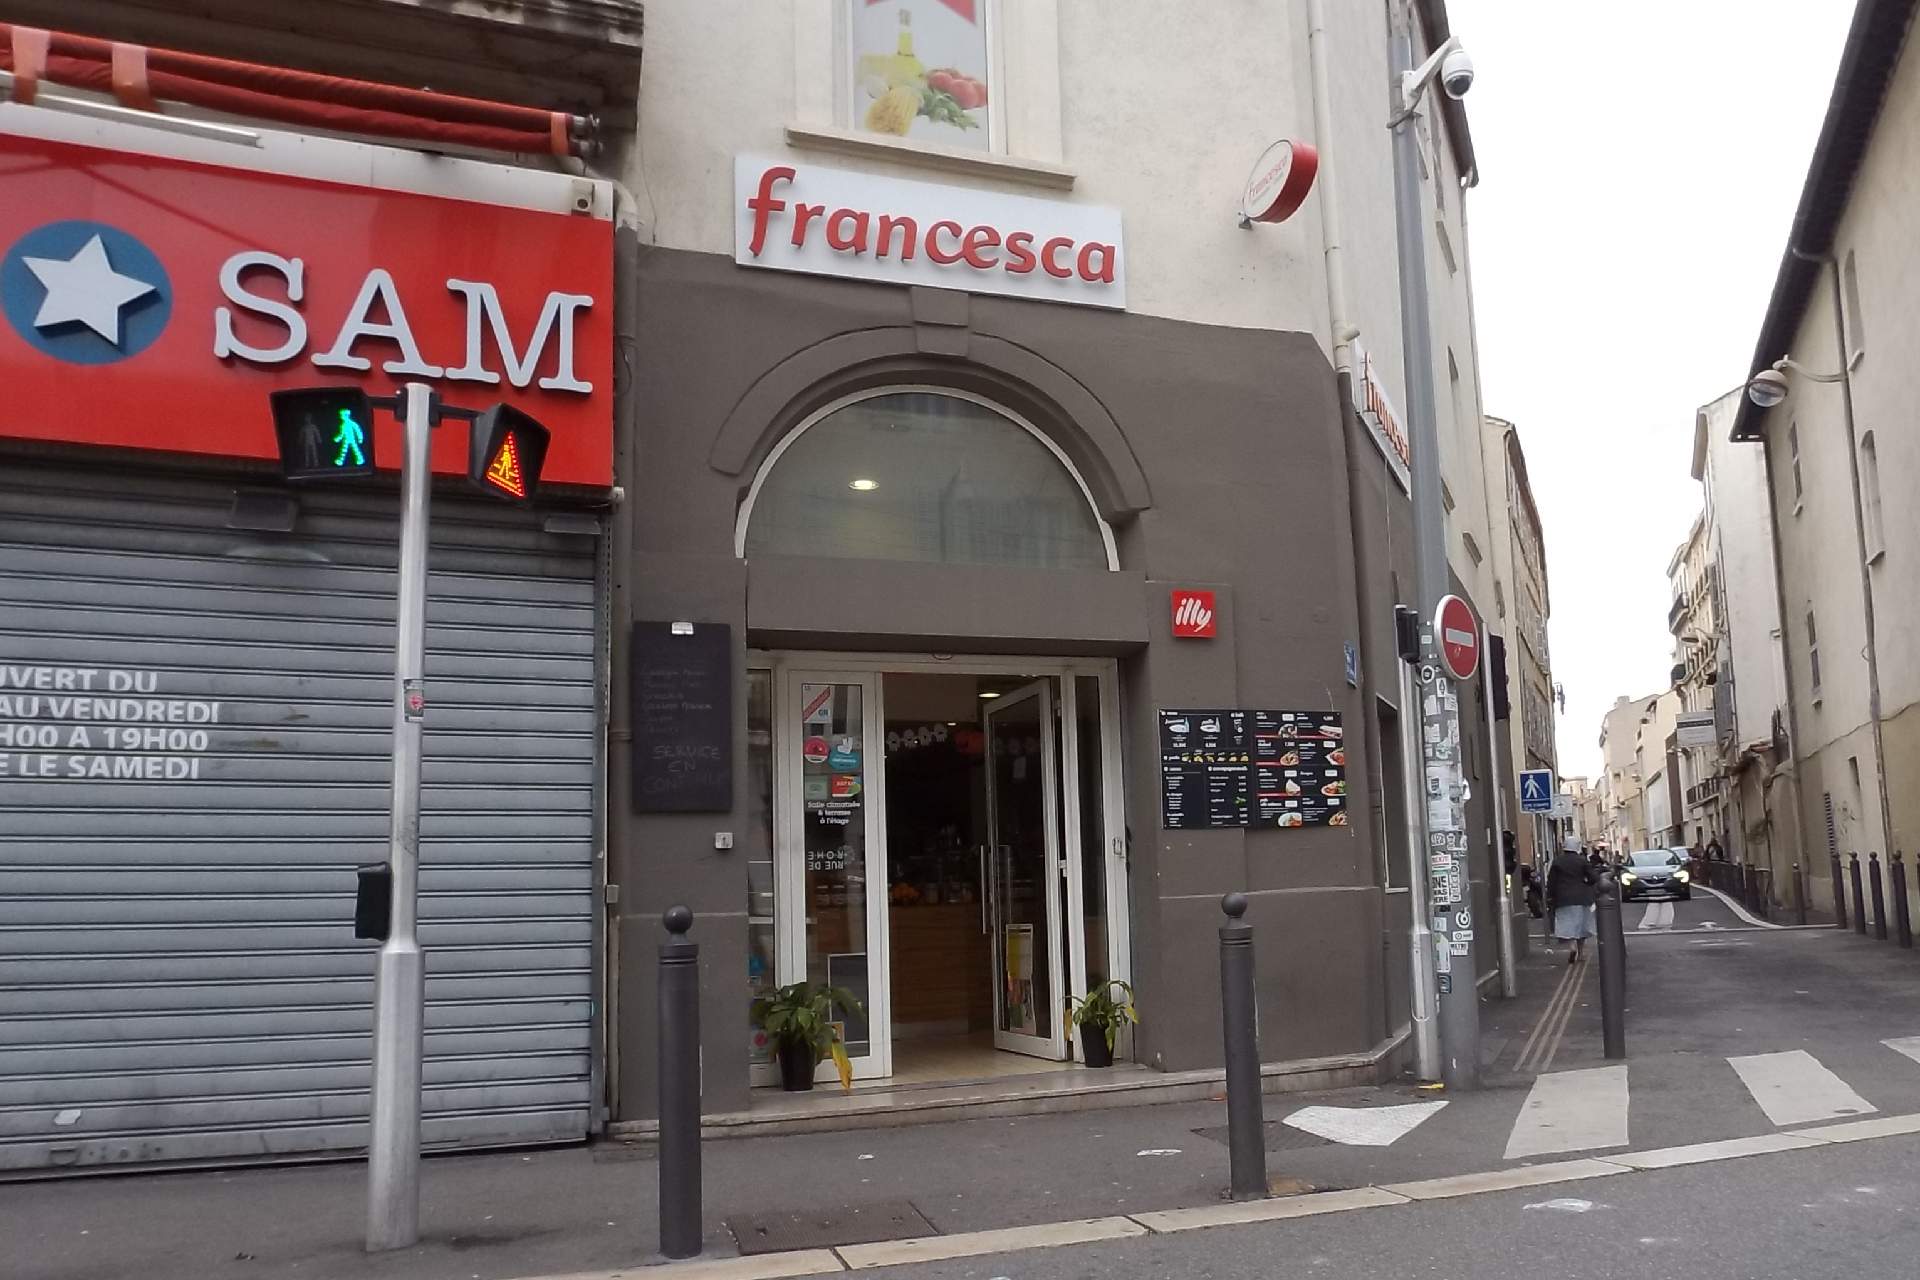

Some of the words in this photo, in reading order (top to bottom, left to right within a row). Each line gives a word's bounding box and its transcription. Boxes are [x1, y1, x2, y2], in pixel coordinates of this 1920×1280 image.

[747, 166, 1116, 285] francesca
[213, 251, 594, 394] SAM
[1175, 597, 1212, 633] illy
[108, 670, 158, 692] DU
[50, 697, 219, 723] VENDREDI
[67, 726, 91, 748] A
[103, 728, 209, 751] 19H00
[19, 754, 58, 777] LE
[67, 755, 200, 779] SAMEDI
